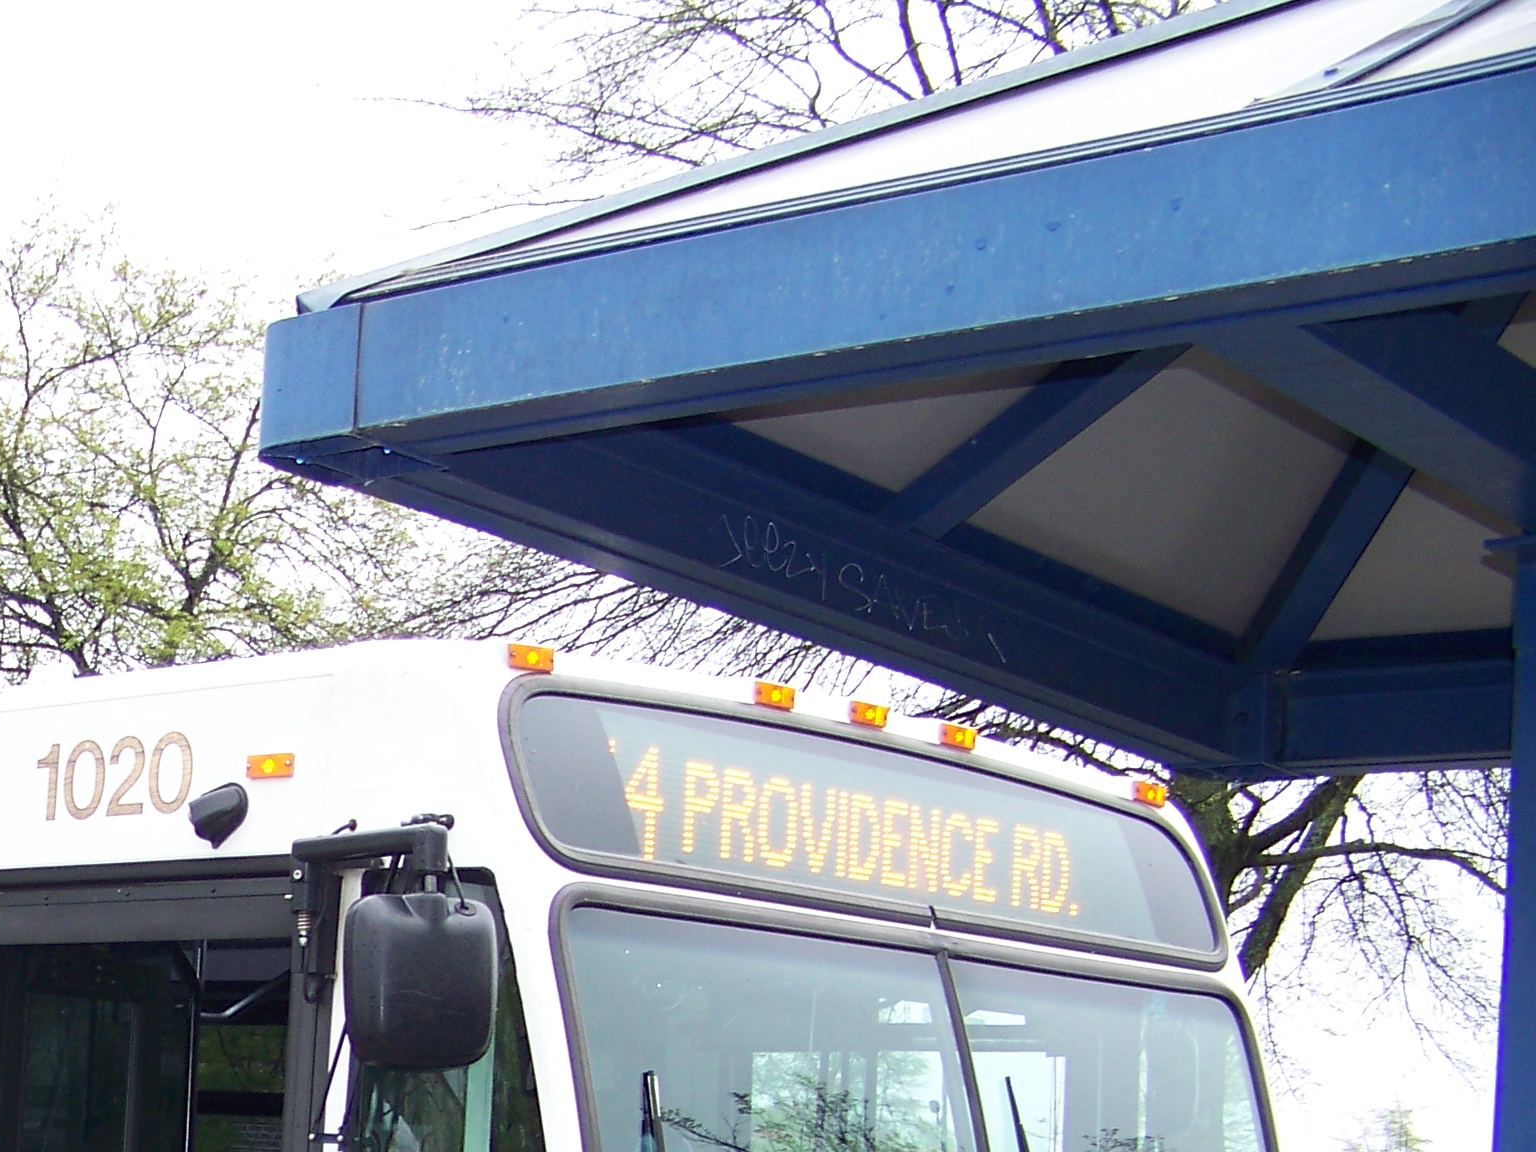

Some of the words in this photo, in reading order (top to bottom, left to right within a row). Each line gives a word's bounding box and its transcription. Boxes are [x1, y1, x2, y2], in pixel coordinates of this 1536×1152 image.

[37, 731, 193, 821] 1020
[607, 738, 664, 861] 4
[681, 759, 998, 903] PROVIDENCE
[1011, 822, 1080, 917] RD.
